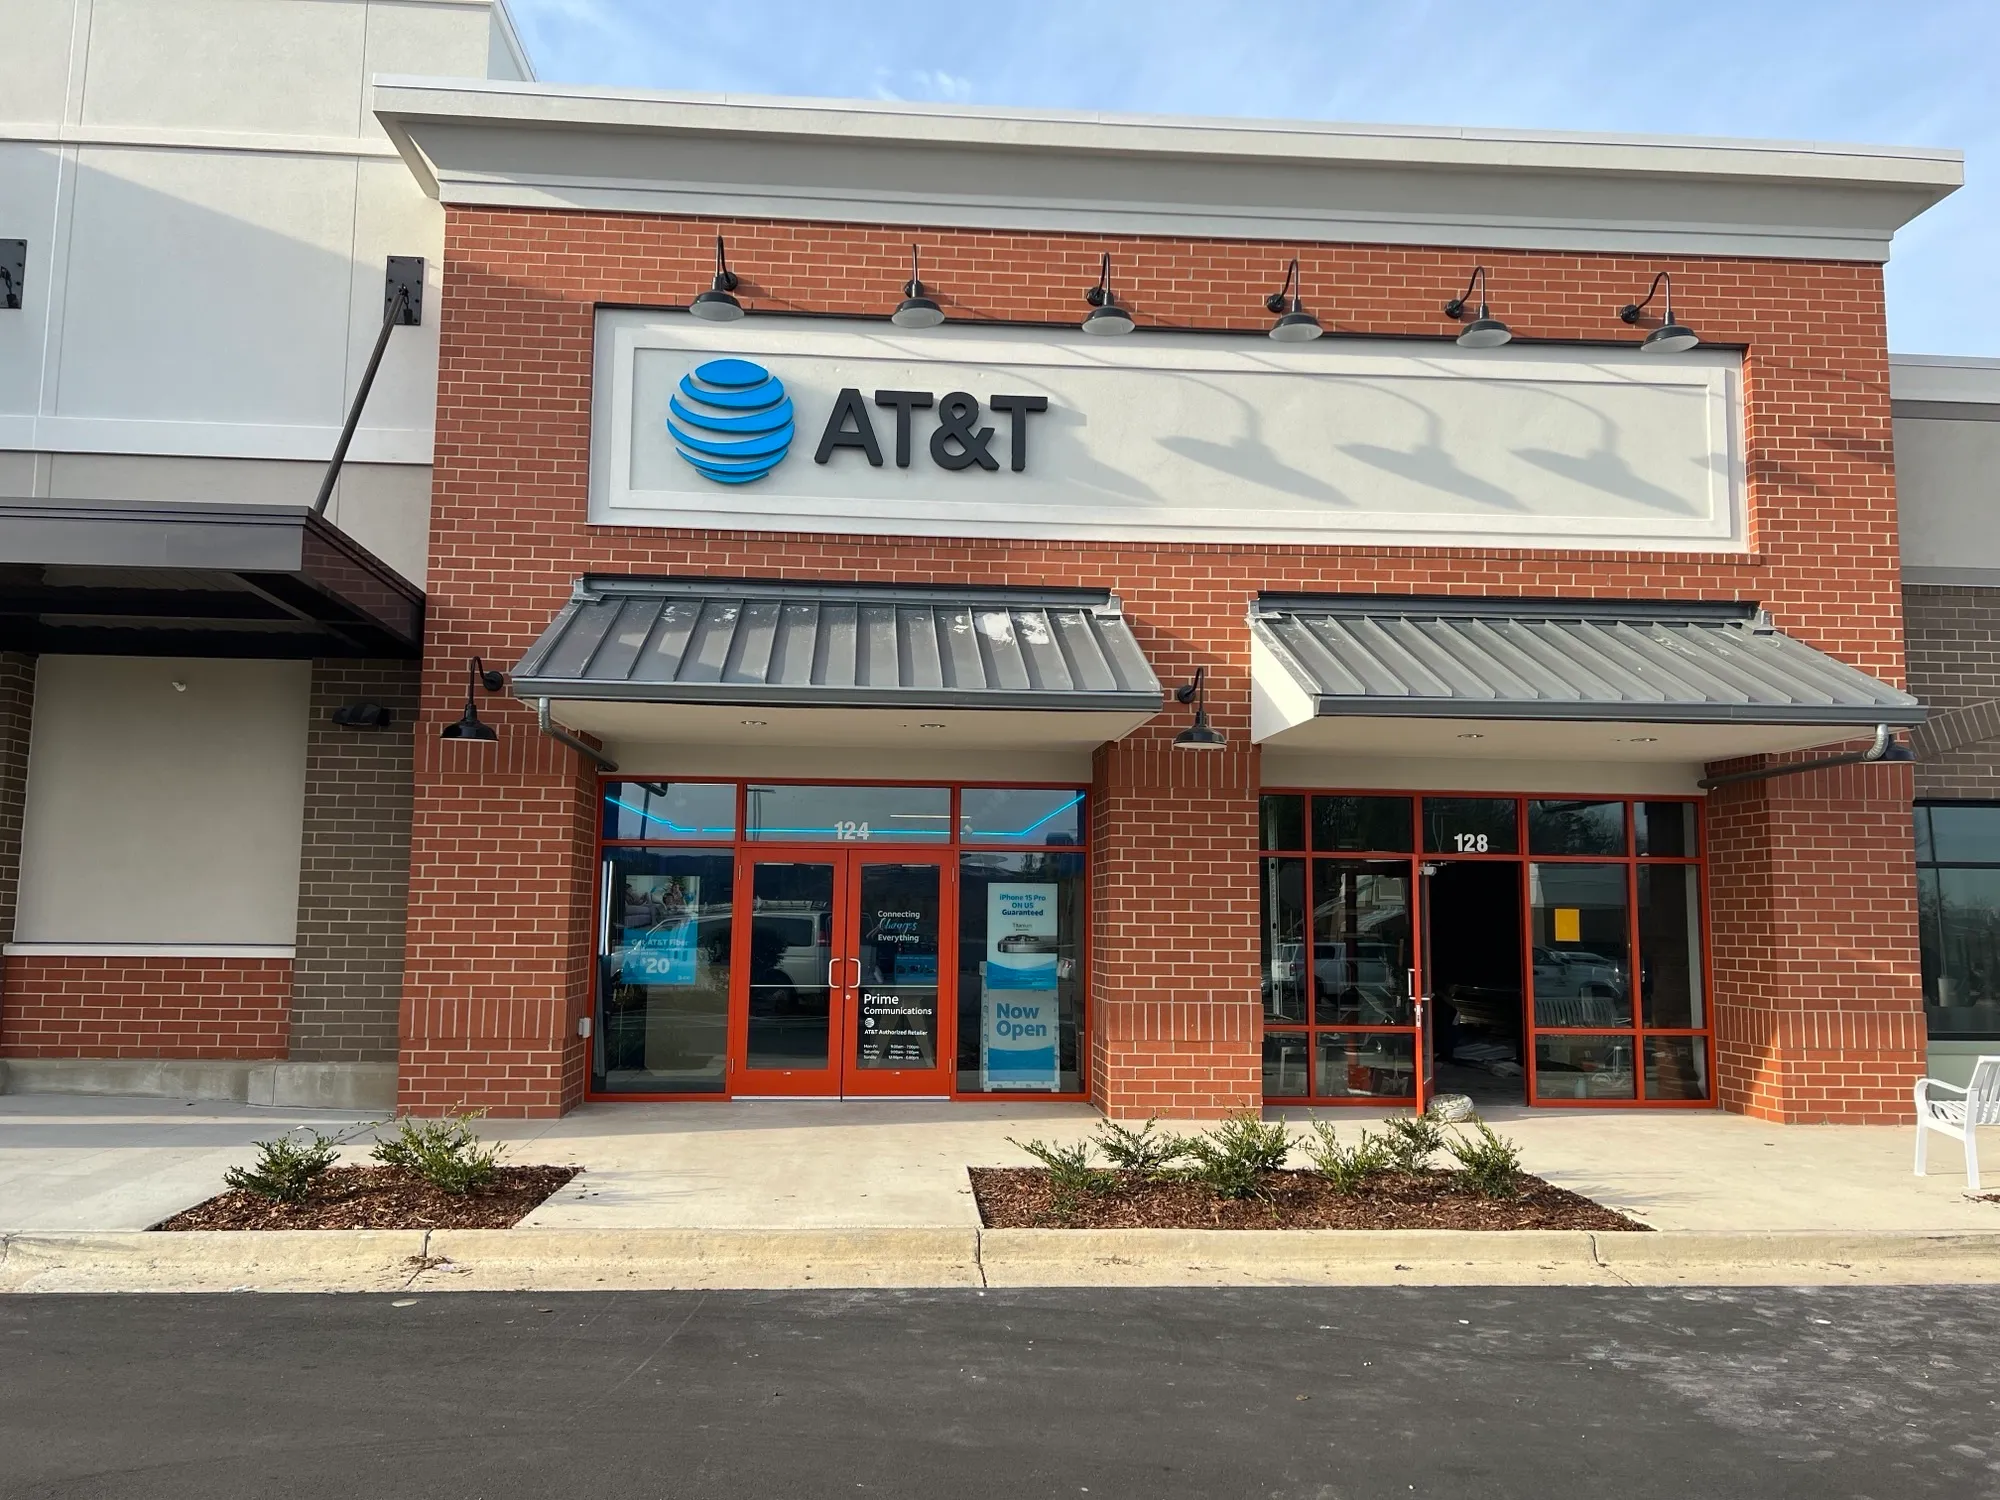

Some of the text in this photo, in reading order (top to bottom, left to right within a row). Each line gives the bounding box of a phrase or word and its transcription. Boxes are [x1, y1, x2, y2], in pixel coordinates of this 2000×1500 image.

[814, 388, 1048, 472] AT&T
[834, 820, 870, 841] 124
[1453, 833, 1489, 853] 128
[999, 893, 1024, 901] iPhone
[877, 910, 921, 920] Connecting
[647, 938, 668, 947] AT&T
[877, 933, 920, 944] Everything
[864, 993, 899, 1005] Prime
[864, 1006, 933, 1016] Communications
[996, 1002, 1040, 1019] Now
[996, 1020, 1048, 1041] Open
